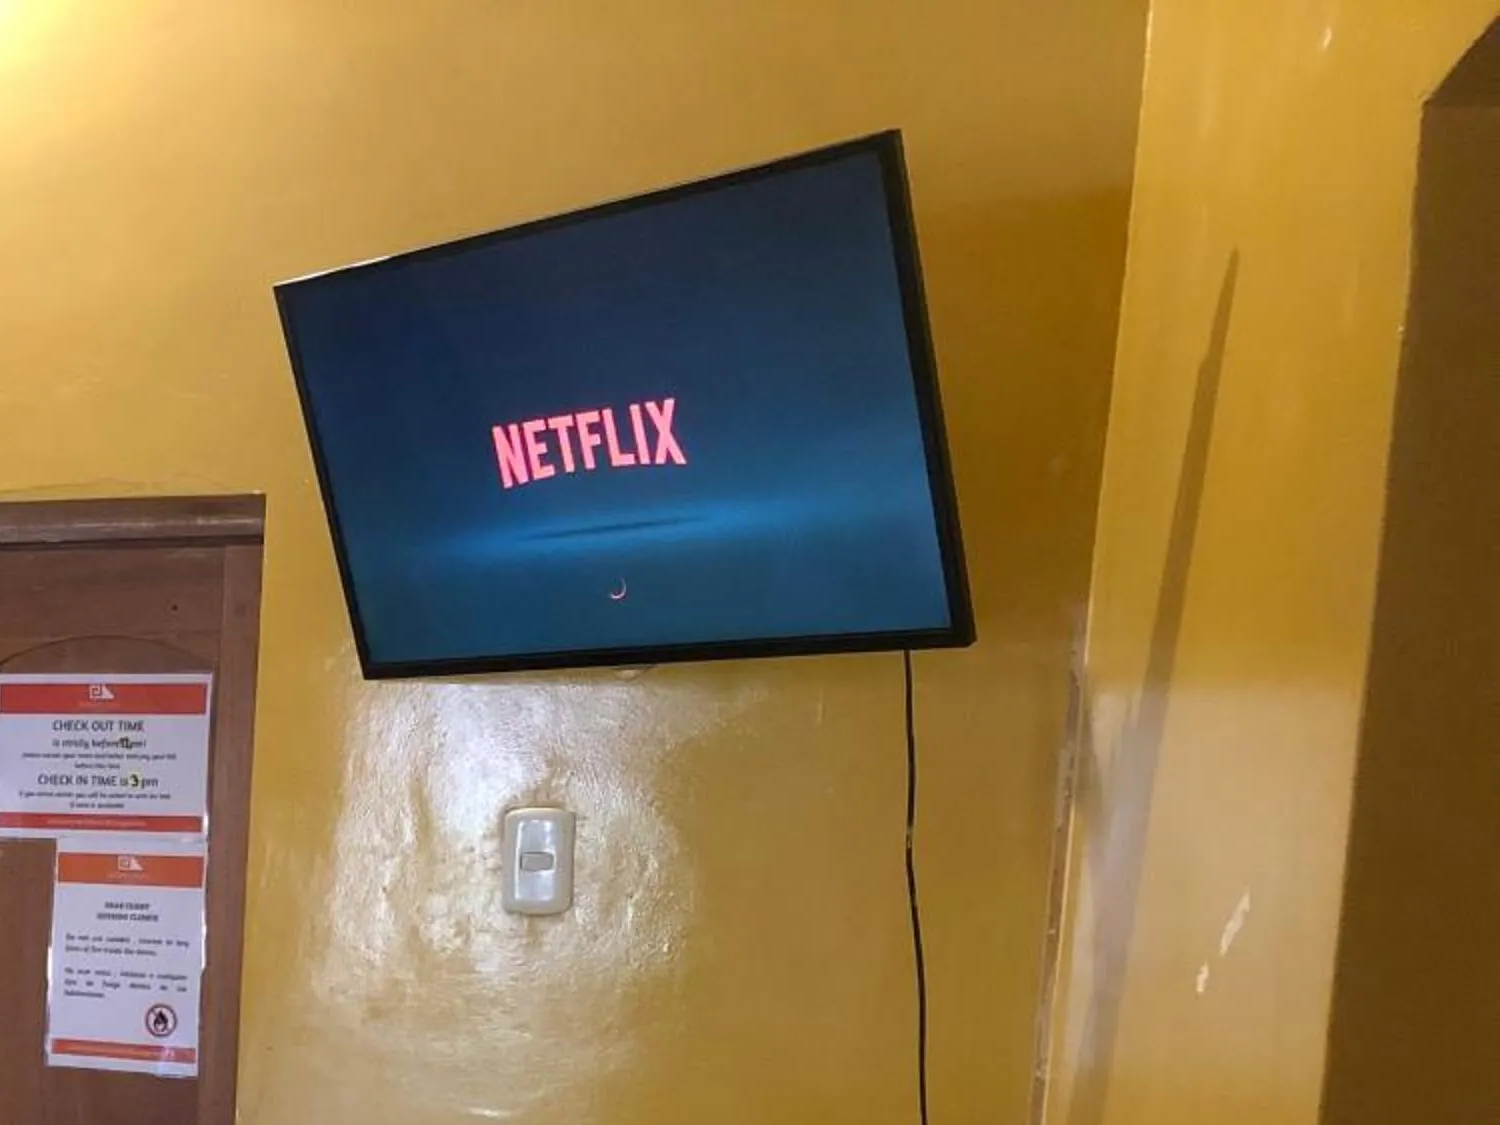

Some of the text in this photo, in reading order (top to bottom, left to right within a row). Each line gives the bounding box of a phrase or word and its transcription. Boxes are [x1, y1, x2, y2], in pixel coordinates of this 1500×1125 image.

[492, 397, 687, 488] NETFLIX
[52, 719, 145, 733] CHECK OUT TIME
[37, 773, 73, 786] CHECK
[75, 774, 89, 786] IN
[91, 774, 117, 787] TIME
[130, 773, 139, 788] 3
[141, 778, 159, 790] pm
